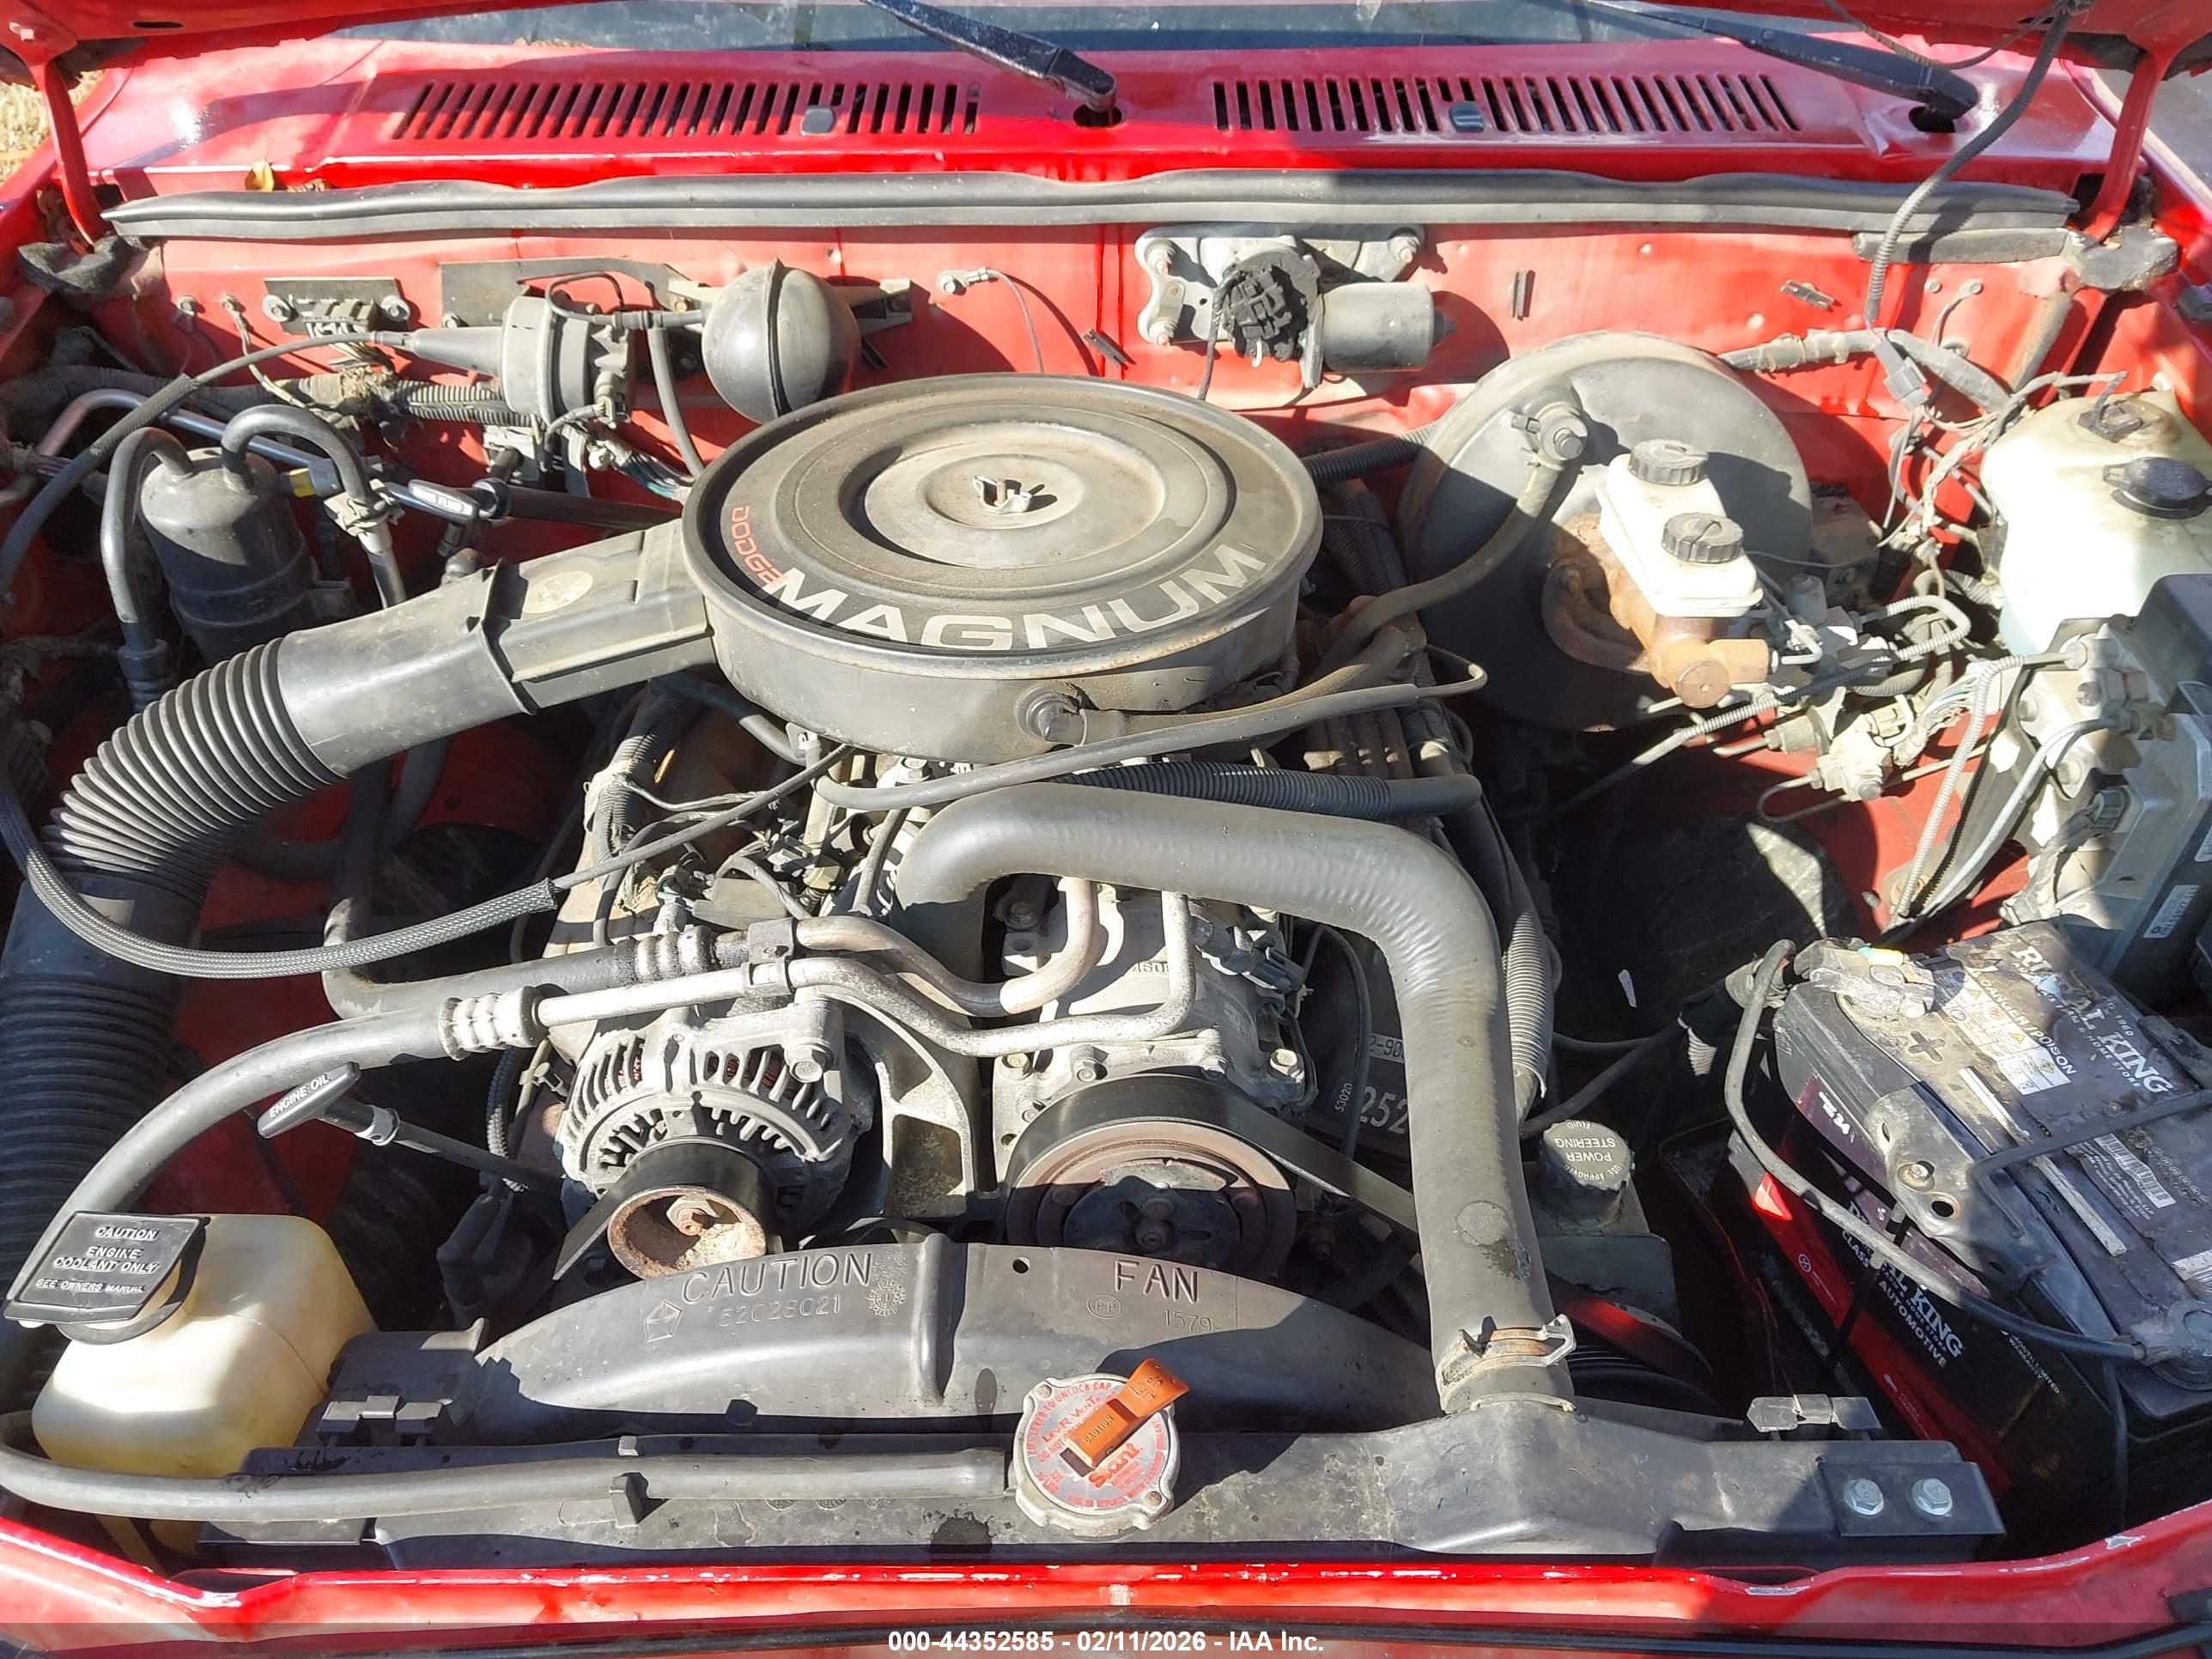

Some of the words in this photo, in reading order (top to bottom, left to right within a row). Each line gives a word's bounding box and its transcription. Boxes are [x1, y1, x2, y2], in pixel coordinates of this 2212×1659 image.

[732, 506, 785, 586] DODGE
[762, 544, 1267, 650] MAGNUM
[2115, 1015, 2135, 1036] 1960
[2087, 1035, 2112, 1060] HOME
[2112, 1061, 2141, 1088] STORE
[2097, 1032, 2174, 1093] KING
[270, 1085, 309, 1118] ENGINE
[310, 1073, 330, 1091] OIL
[1334, 1083, 1352, 1112] 53020
[1567, 1121, 1591, 1129] FLUID
[1554, 1138, 1616, 1148] STEERING
[1566, 1152, 1612, 1162] POWER
[1564, 1164, 1605, 1181] APPROVED
[1607, 1164, 1623, 1176] USE
[94, 1227, 159, 1241] CAUTION
[53, 1257, 118, 1273] COOLANT
[120, 1261, 159, 1274] ONLY
[86, 1246, 143, 1260] ENGINE
[35, 1279, 58, 1288] SEE
[60, 1280, 103, 1292] OWNERS
[105, 1284, 144, 1293] MANUAL
[682, 1252, 872, 1305] CAUTION
[1115, 1259, 1200, 1304] FAN
[1842, 1230, 1870, 1267] CLASS
[1878, 1280, 1948, 1368] AUTOMOTIVE
[1911, 1289, 1965, 1358] KING
[2009, 1338, 2042, 1379] WARRANTY
[1056, 1383, 1091, 1403] UNLOCK
[1092, 1381, 1112, 1391] CAP
[1084, 1414, 1115, 1443] CAUTION
